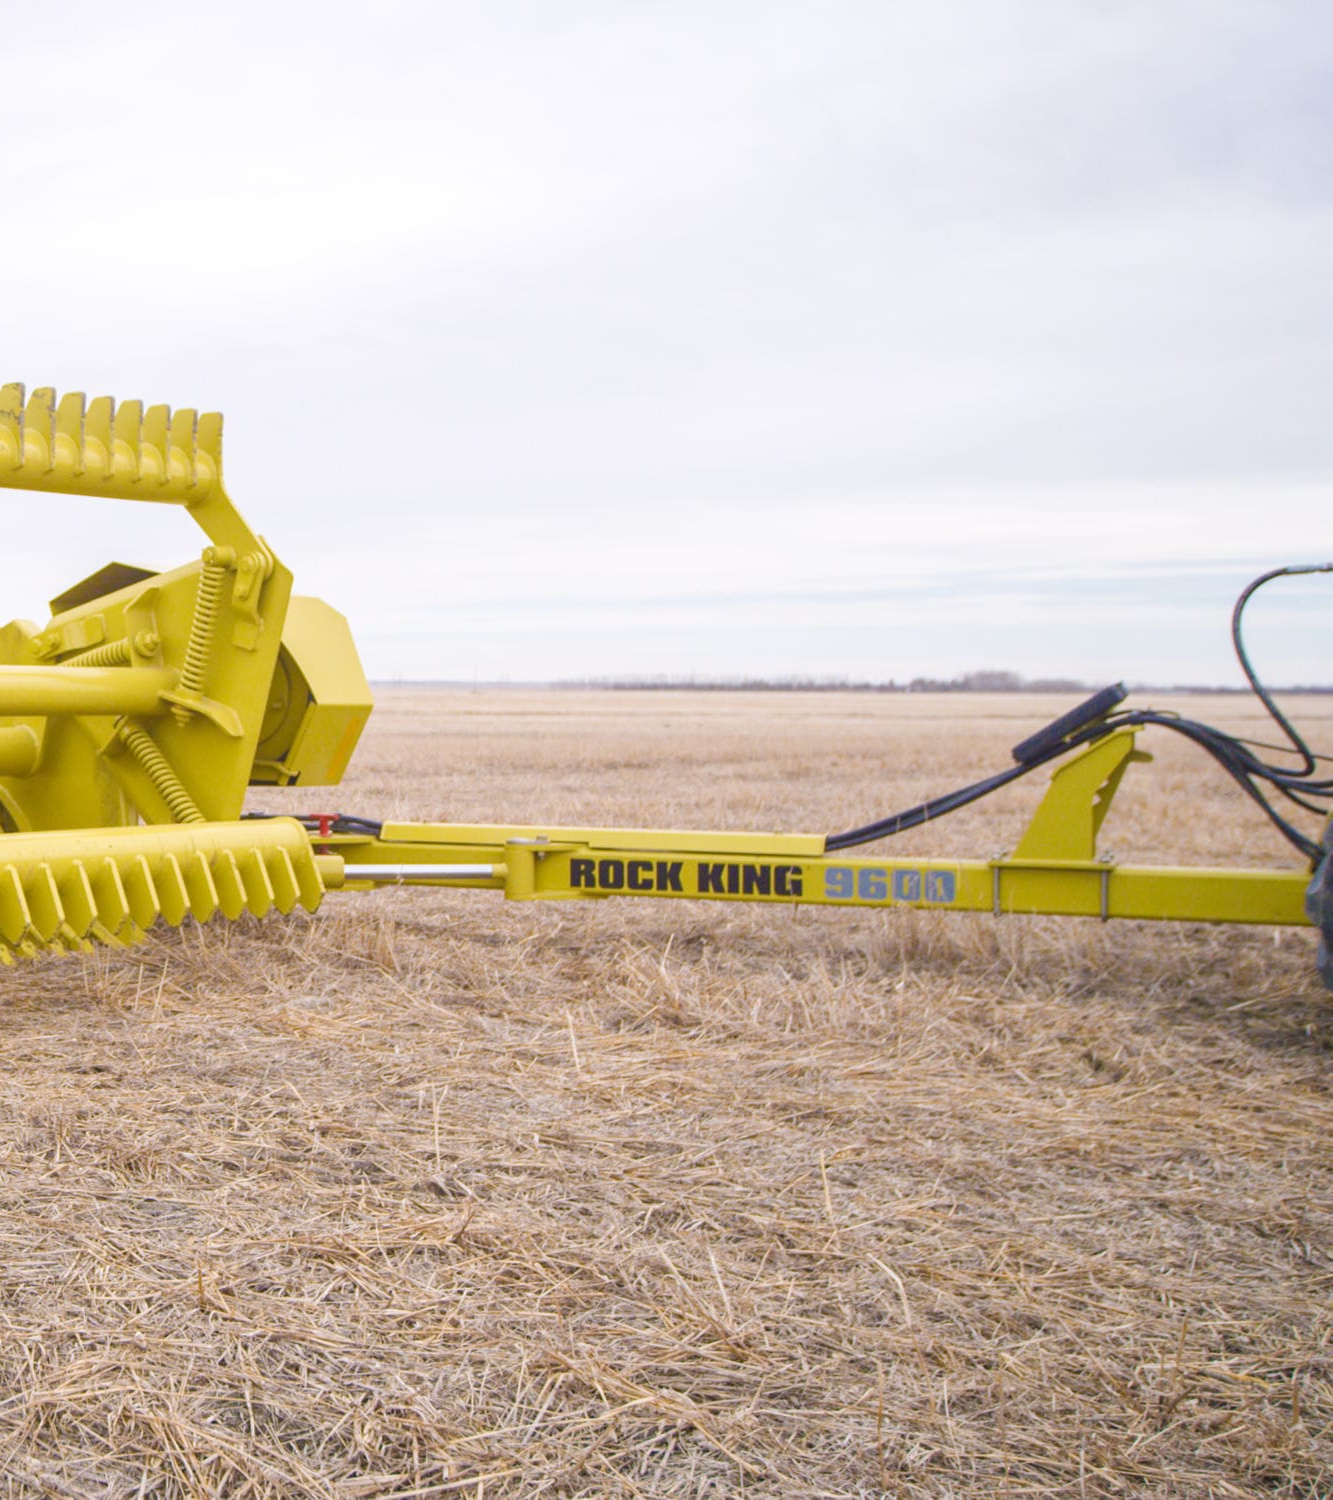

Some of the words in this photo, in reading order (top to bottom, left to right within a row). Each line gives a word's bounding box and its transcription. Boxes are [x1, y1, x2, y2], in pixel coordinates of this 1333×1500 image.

[570, 859, 683, 891] ROCK
[698, 864, 803, 896] KING
[824, 867, 955, 902] 9600
